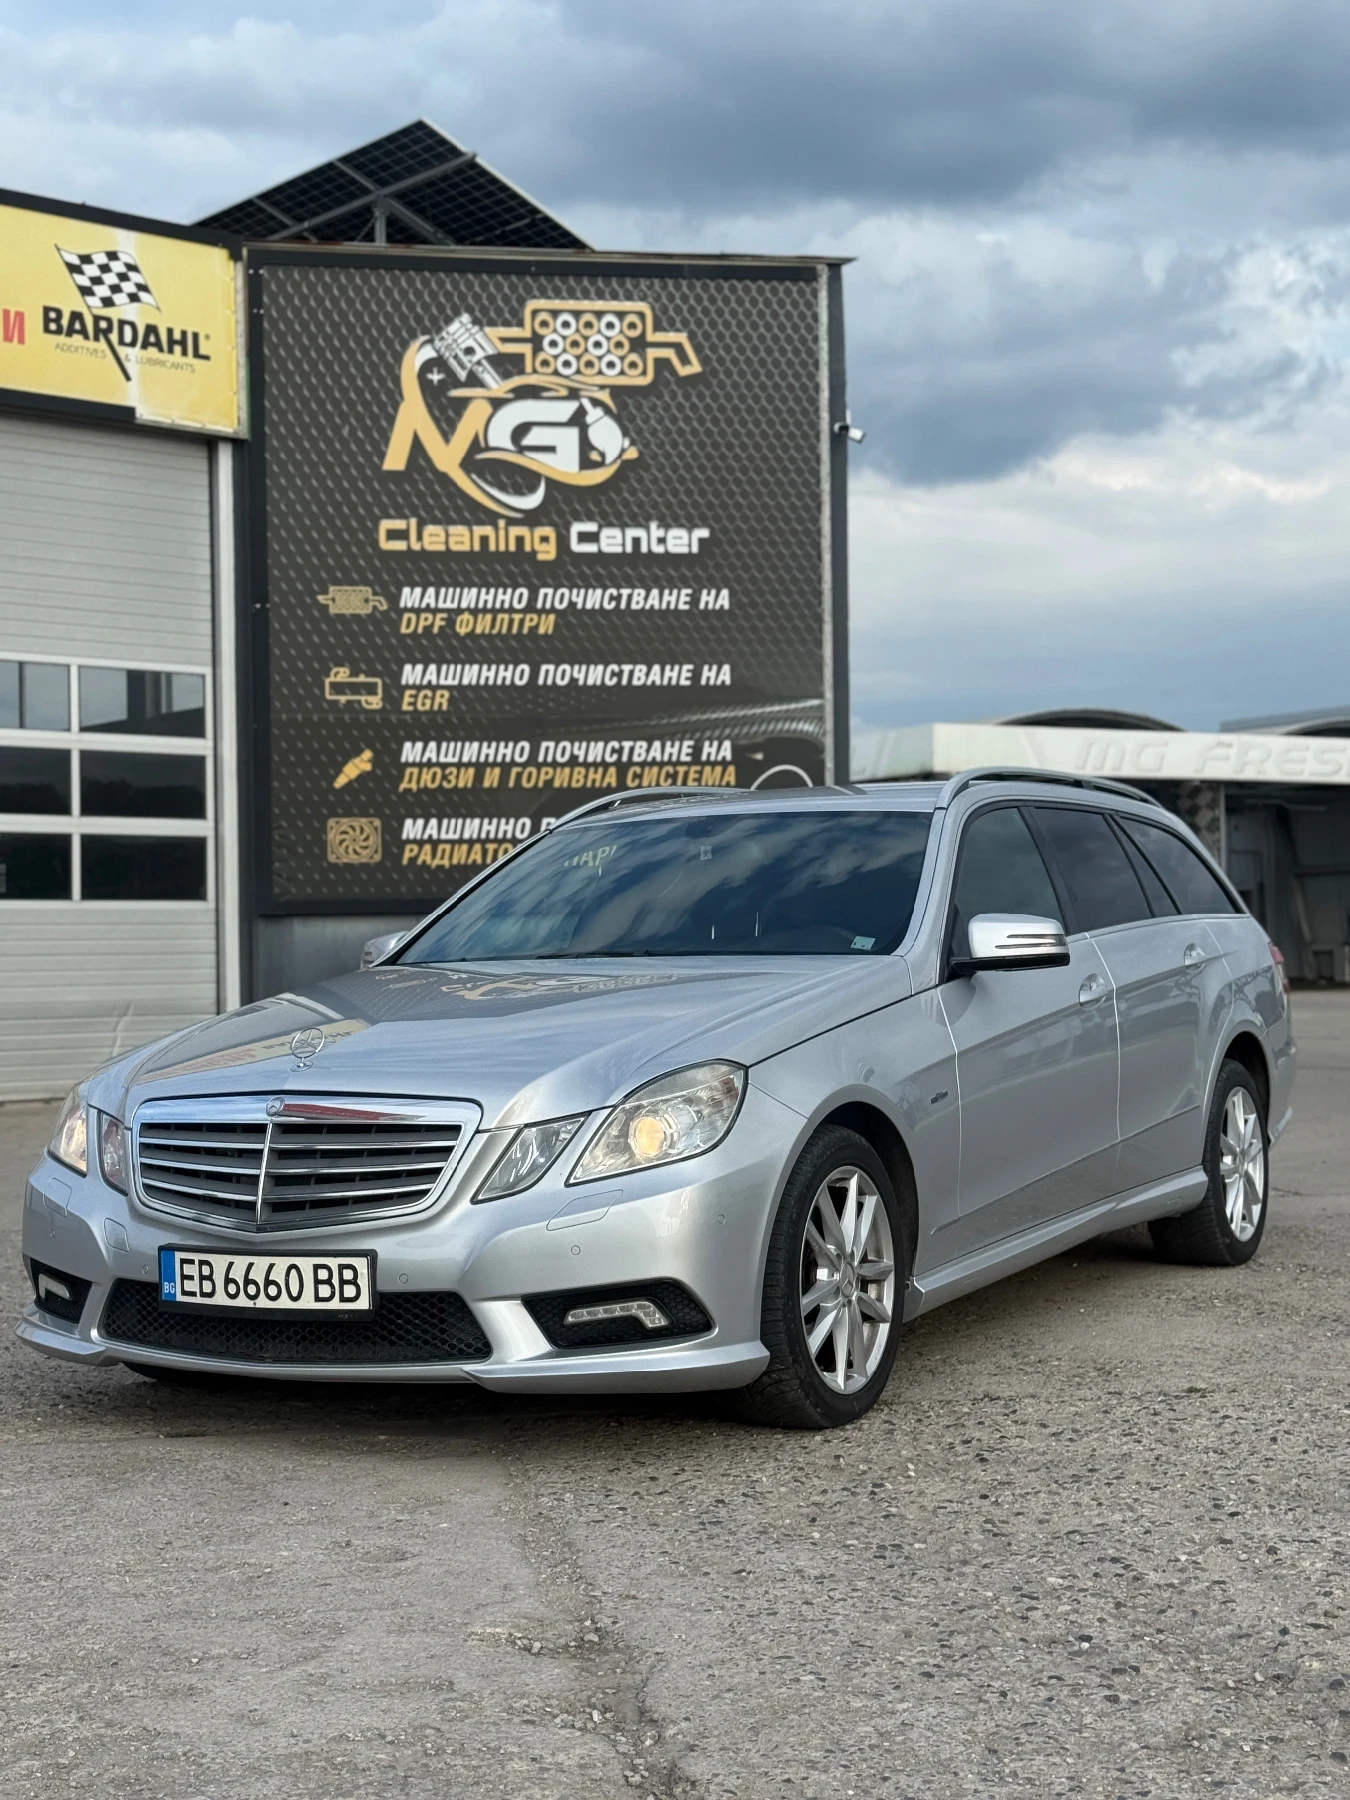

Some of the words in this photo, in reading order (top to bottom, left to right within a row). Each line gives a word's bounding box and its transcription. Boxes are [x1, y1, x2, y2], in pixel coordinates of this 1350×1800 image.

[42, 305, 211, 362] BARDAHL
[54, 341, 107, 360] ADDITIVES
[135, 353, 197, 374] LUBRICANTS
[378, 519, 557, 561] Cleaning
[569, 520, 711, 554] Center
[399, 587, 528, 610] МАШИННО
[537, 587, 693, 610] ПОЧИСТВАНЕ
[699, 588, 730, 610] НА
[400, 612, 446, 634] DPF
[456, 612, 556, 635] ФИЛТРИ
[401, 664, 530, 686] МАШИННО
[538, 664, 695, 686] ПОЧИСТВАНЕ
[701, 664, 731, 686] НА
[401, 690, 450, 711] EGR
[401, 741, 530, 763] МАШИННО
[538, 741, 695, 763] ПОЧИСТВАНЕ
[701, 740, 732, 762] НА
[1194, 739, 1350, 780] FRES
[399, 767, 476, 792] ДЮЗИ
[483, 767, 501, 788] И
[508, 767, 617, 788] ГОРИВНА
[627, 765, 736, 788] СИСТЕМА
[402, 818, 531, 840] МАШИННО
[402, 843, 520, 868] РАДИАТО
[164, 1282, 175, 1294] BG
[179, 1258, 217, 1299] EB
[223, 1261, 305, 1303] 6660
[312, 1263, 362, 1303] BB
